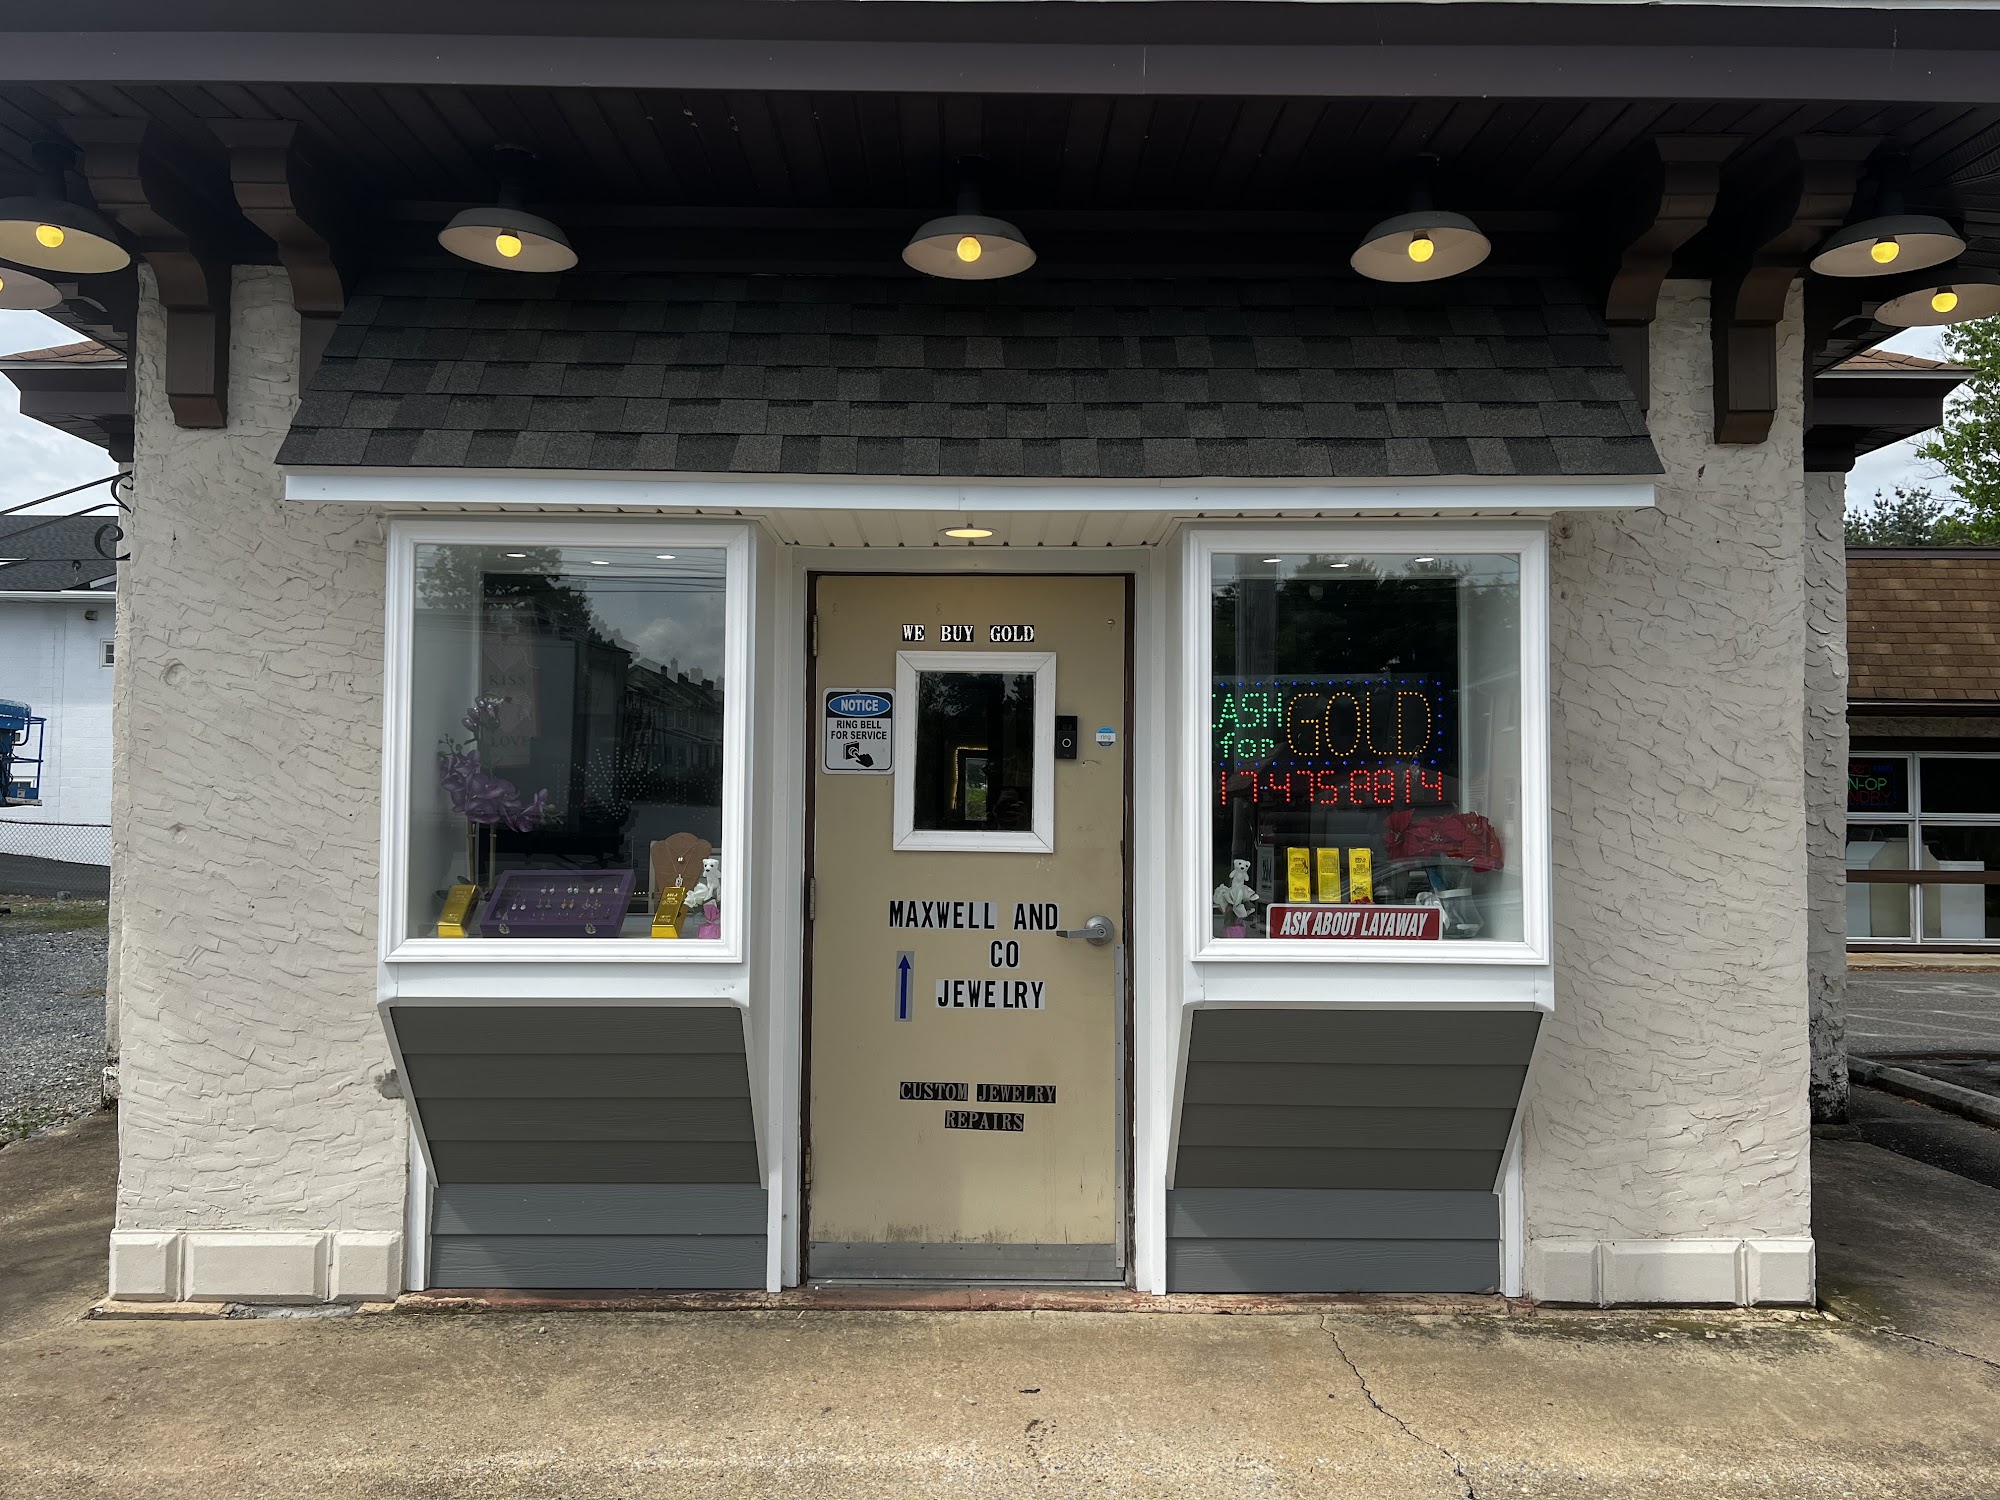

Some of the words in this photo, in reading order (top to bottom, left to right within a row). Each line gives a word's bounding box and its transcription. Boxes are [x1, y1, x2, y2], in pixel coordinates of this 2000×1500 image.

[902, 624, 925, 641] WE
[940, 625, 974, 642] BUY
[990, 625, 1034, 642] GOLD
[841, 699, 879, 711] NOTICE
[1211, 692, 1283, 728] ASH
[831, 730, 848, 740] FOR
[850, 730, 887, 740] SERVICE
[836, 720, 858, 729] RING
[860, 720, 882, 729] BELL
[1286, 690, 1432, 757] GOLD
[1219, 731, 1275, 759] for
[889, 900, 995, 930] MAXWELL
[1013, 903, 1058, 931] AND
[1280, 911, 1312, 936] ASK
[1311, 912, 1360, 937] ABOUT
[1360, 912, 1429, 937] LAYAWAY
[990, 940, 1019, 968] CO
[937, 979, 1044, 1009] JEWELRY
[900, 1082, 968, 1100] CUSTOM
[978, 1084, 1056, 1103] JEWELRY
[945, 1110, 1024, 1131] REPAIRS
